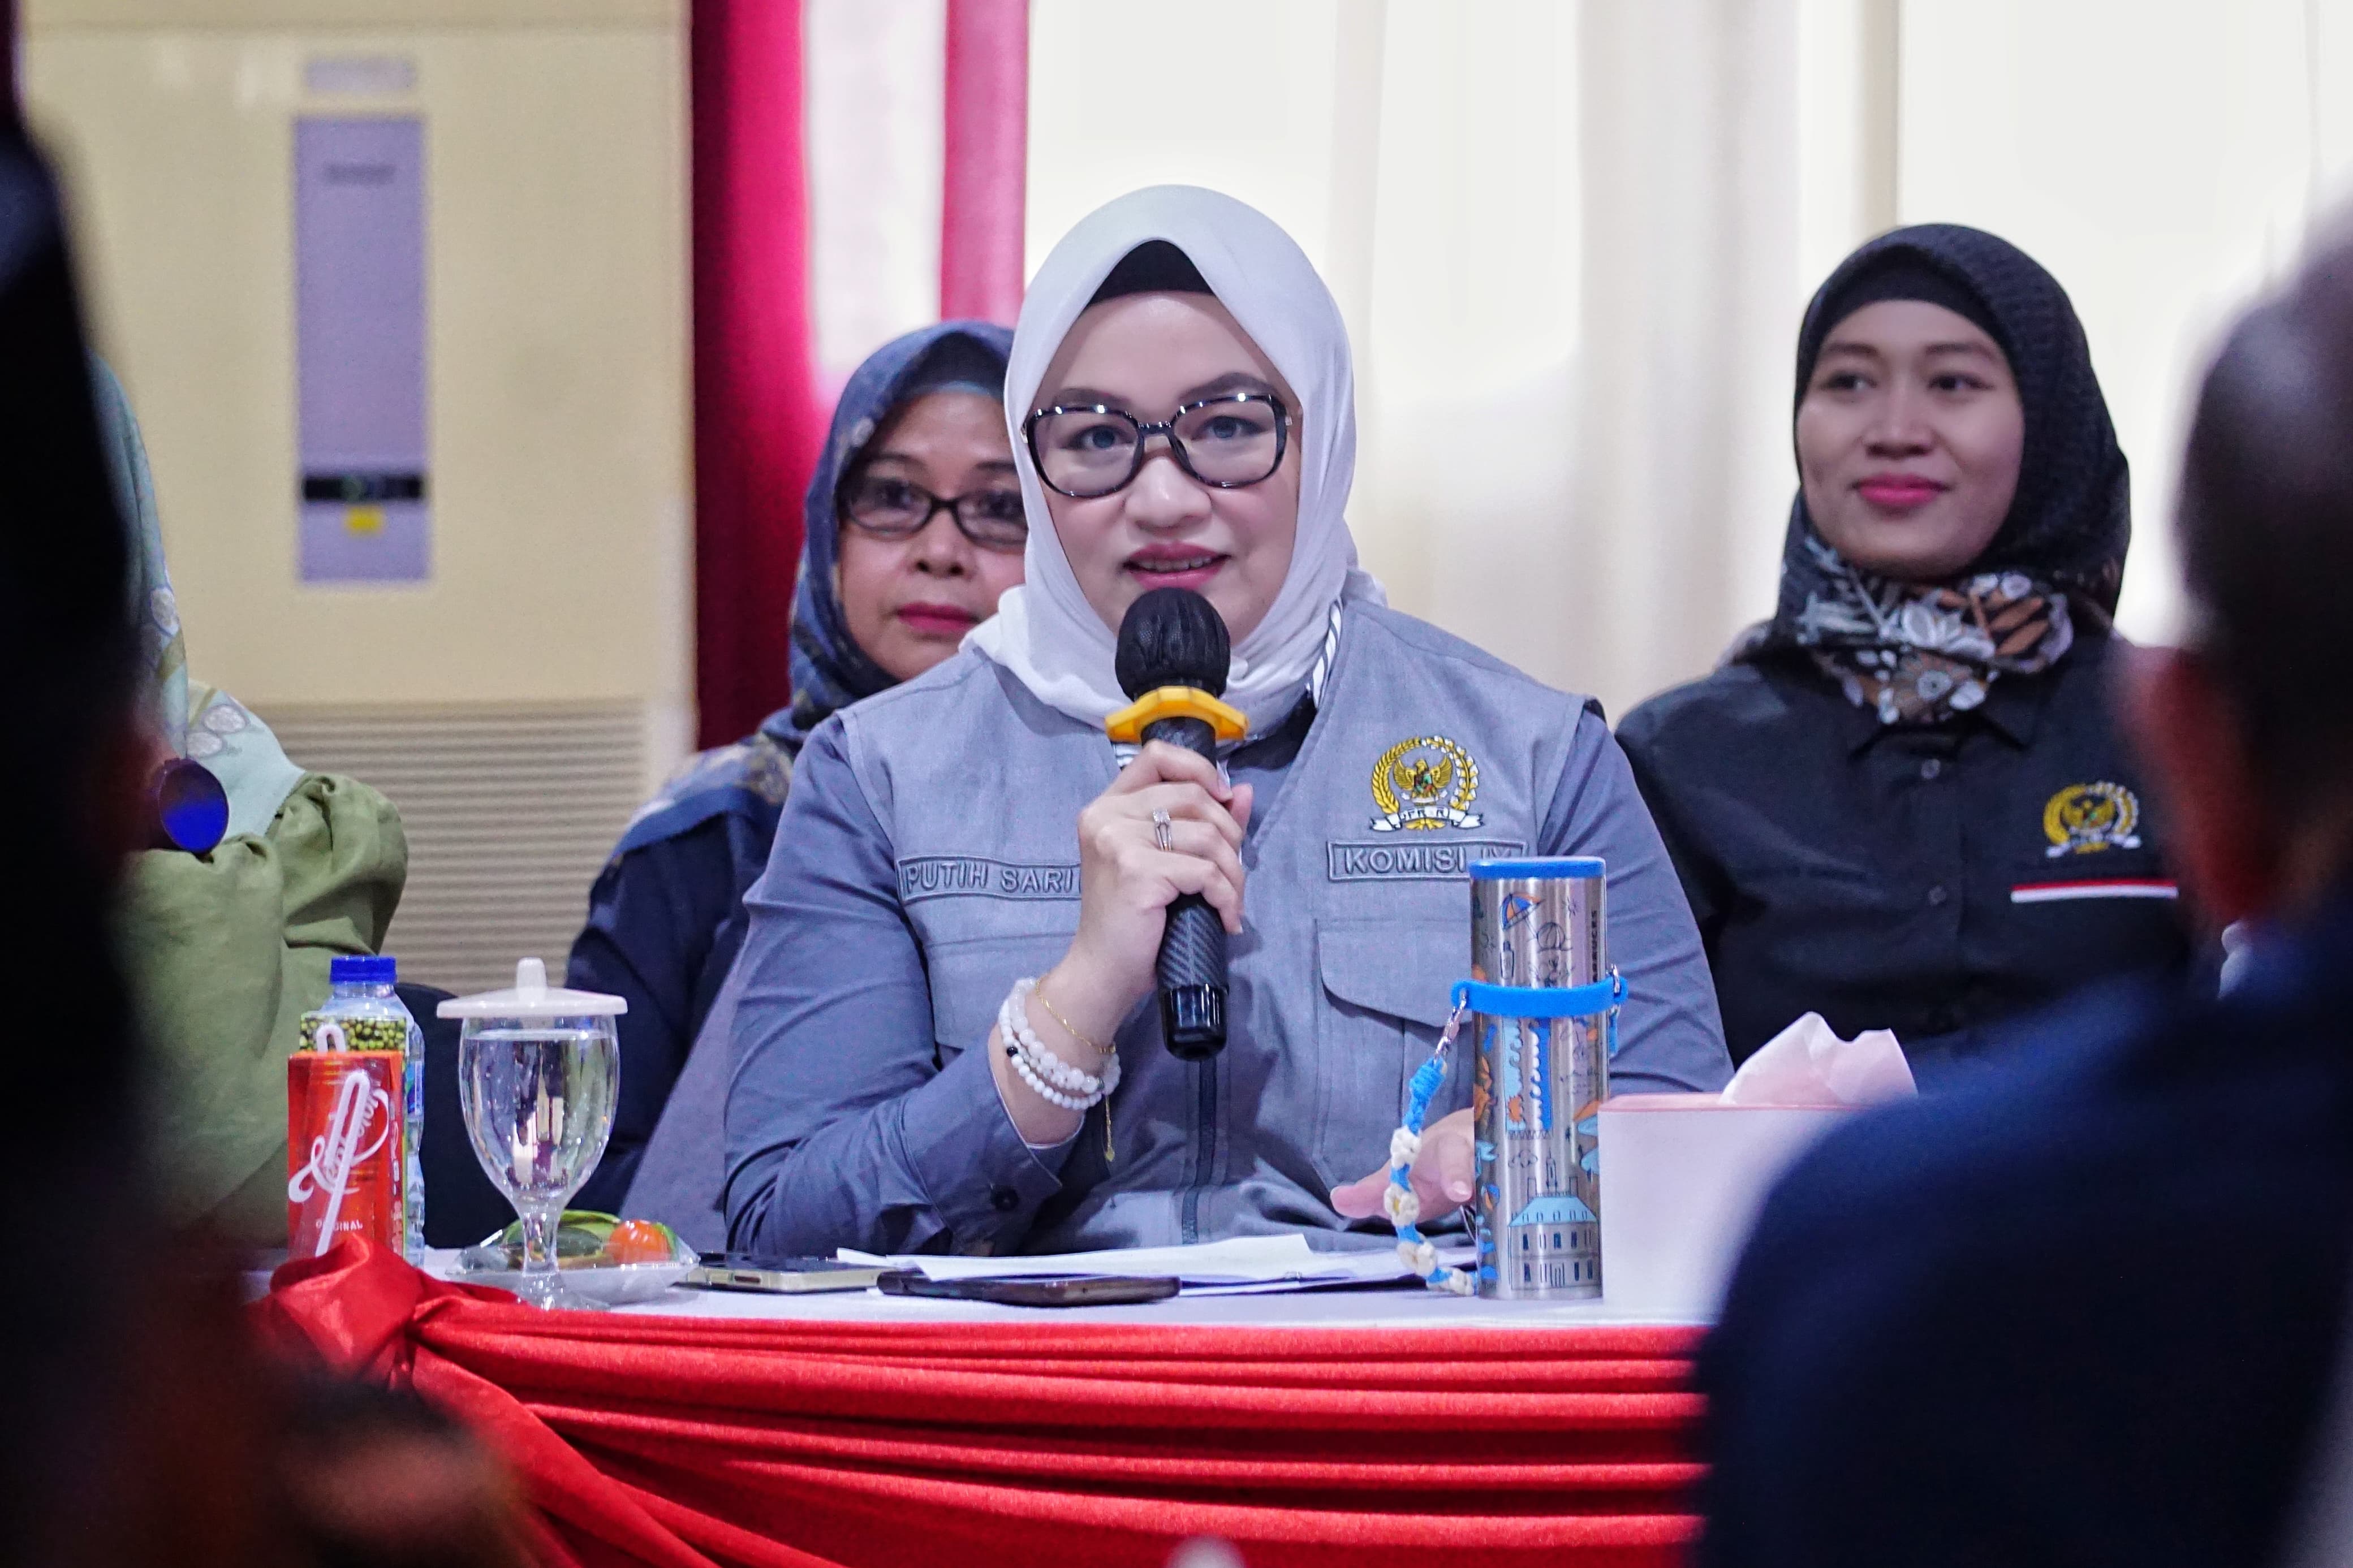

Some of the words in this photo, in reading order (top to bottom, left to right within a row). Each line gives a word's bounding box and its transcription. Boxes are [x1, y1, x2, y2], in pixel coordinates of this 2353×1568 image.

[1344, 846, 1466, 874] KOMISI
[904, 861, 989, 894] PUTIH
[1001, 868, 1074, 893] SARI
